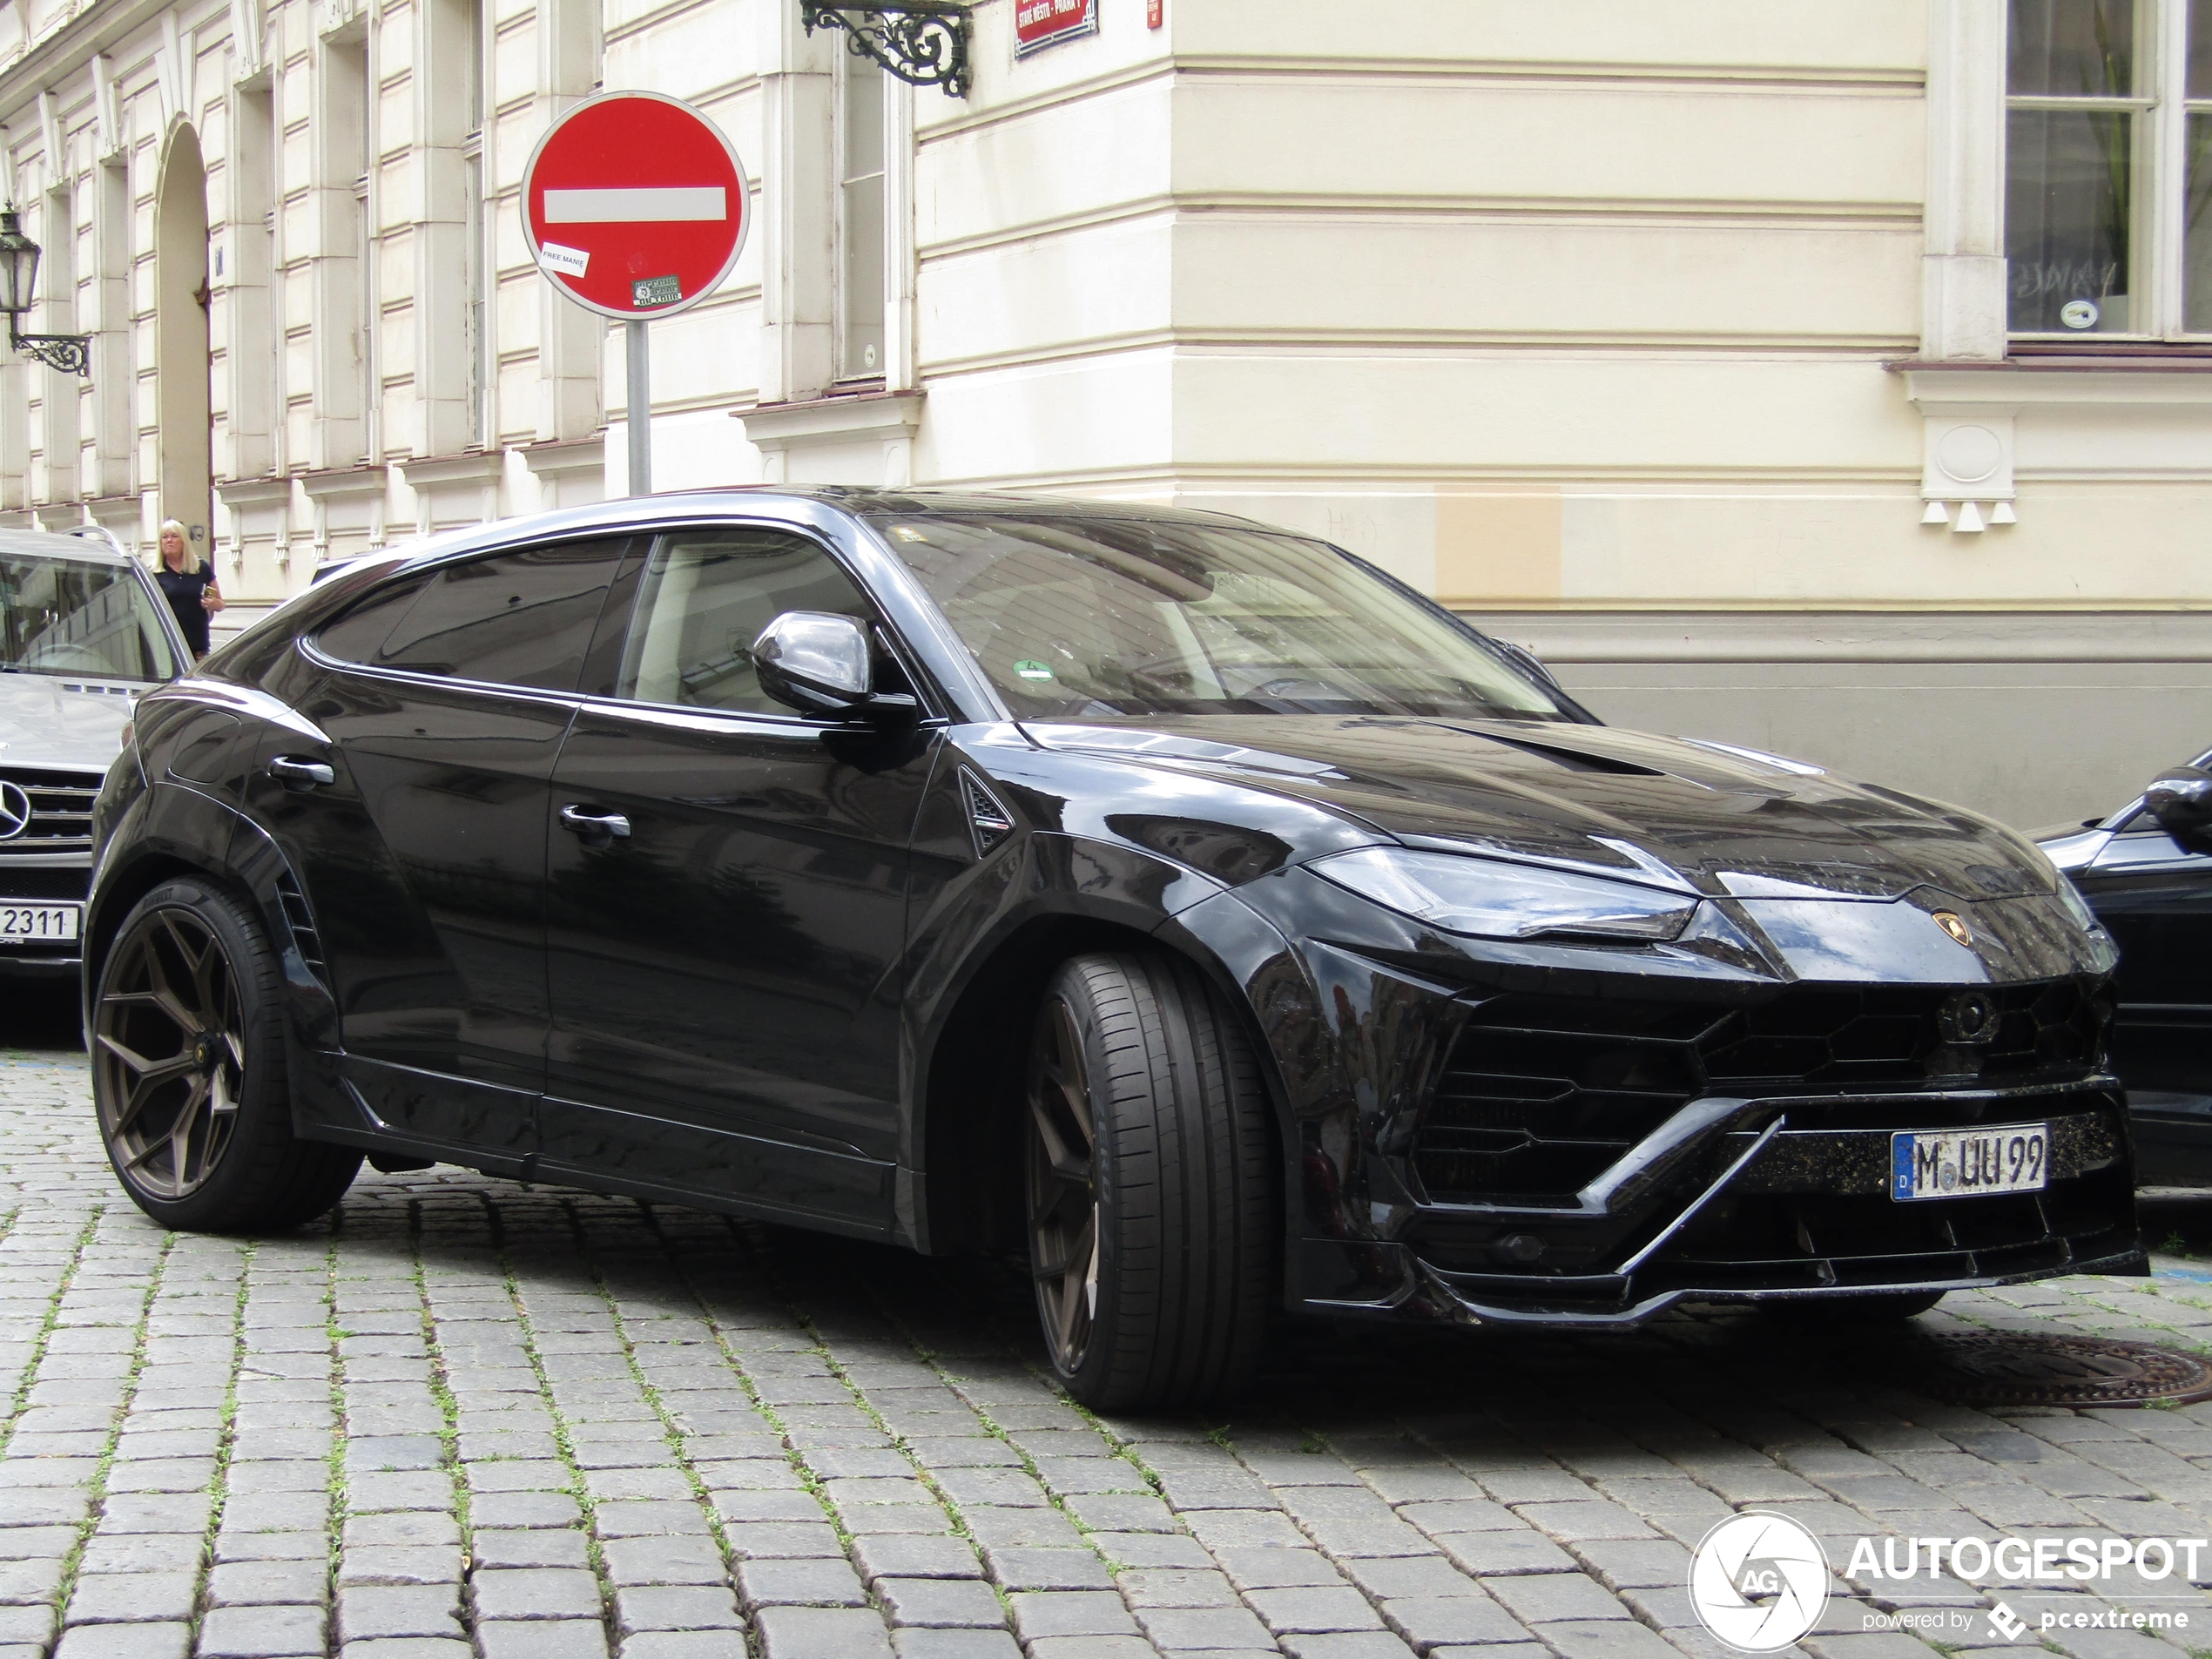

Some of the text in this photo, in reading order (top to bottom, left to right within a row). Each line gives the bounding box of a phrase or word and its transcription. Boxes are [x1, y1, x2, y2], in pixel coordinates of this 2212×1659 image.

[1019, 5, 1033, 28] STARÉ
[1033, 3, 1050, 23] MĚSTO
[1055, 0, 1076, 14] PRAHA
[543, 252, 562, 260] FREE
[654, 294, 679, 303] TOUR
[3, 909, 64, 934] 2311
[1095, 1095, 1112, 1205] ZERO
[1917, 1135, 2043, 1190] M UU 99
[1899, 1175, 1907, 1189] D
